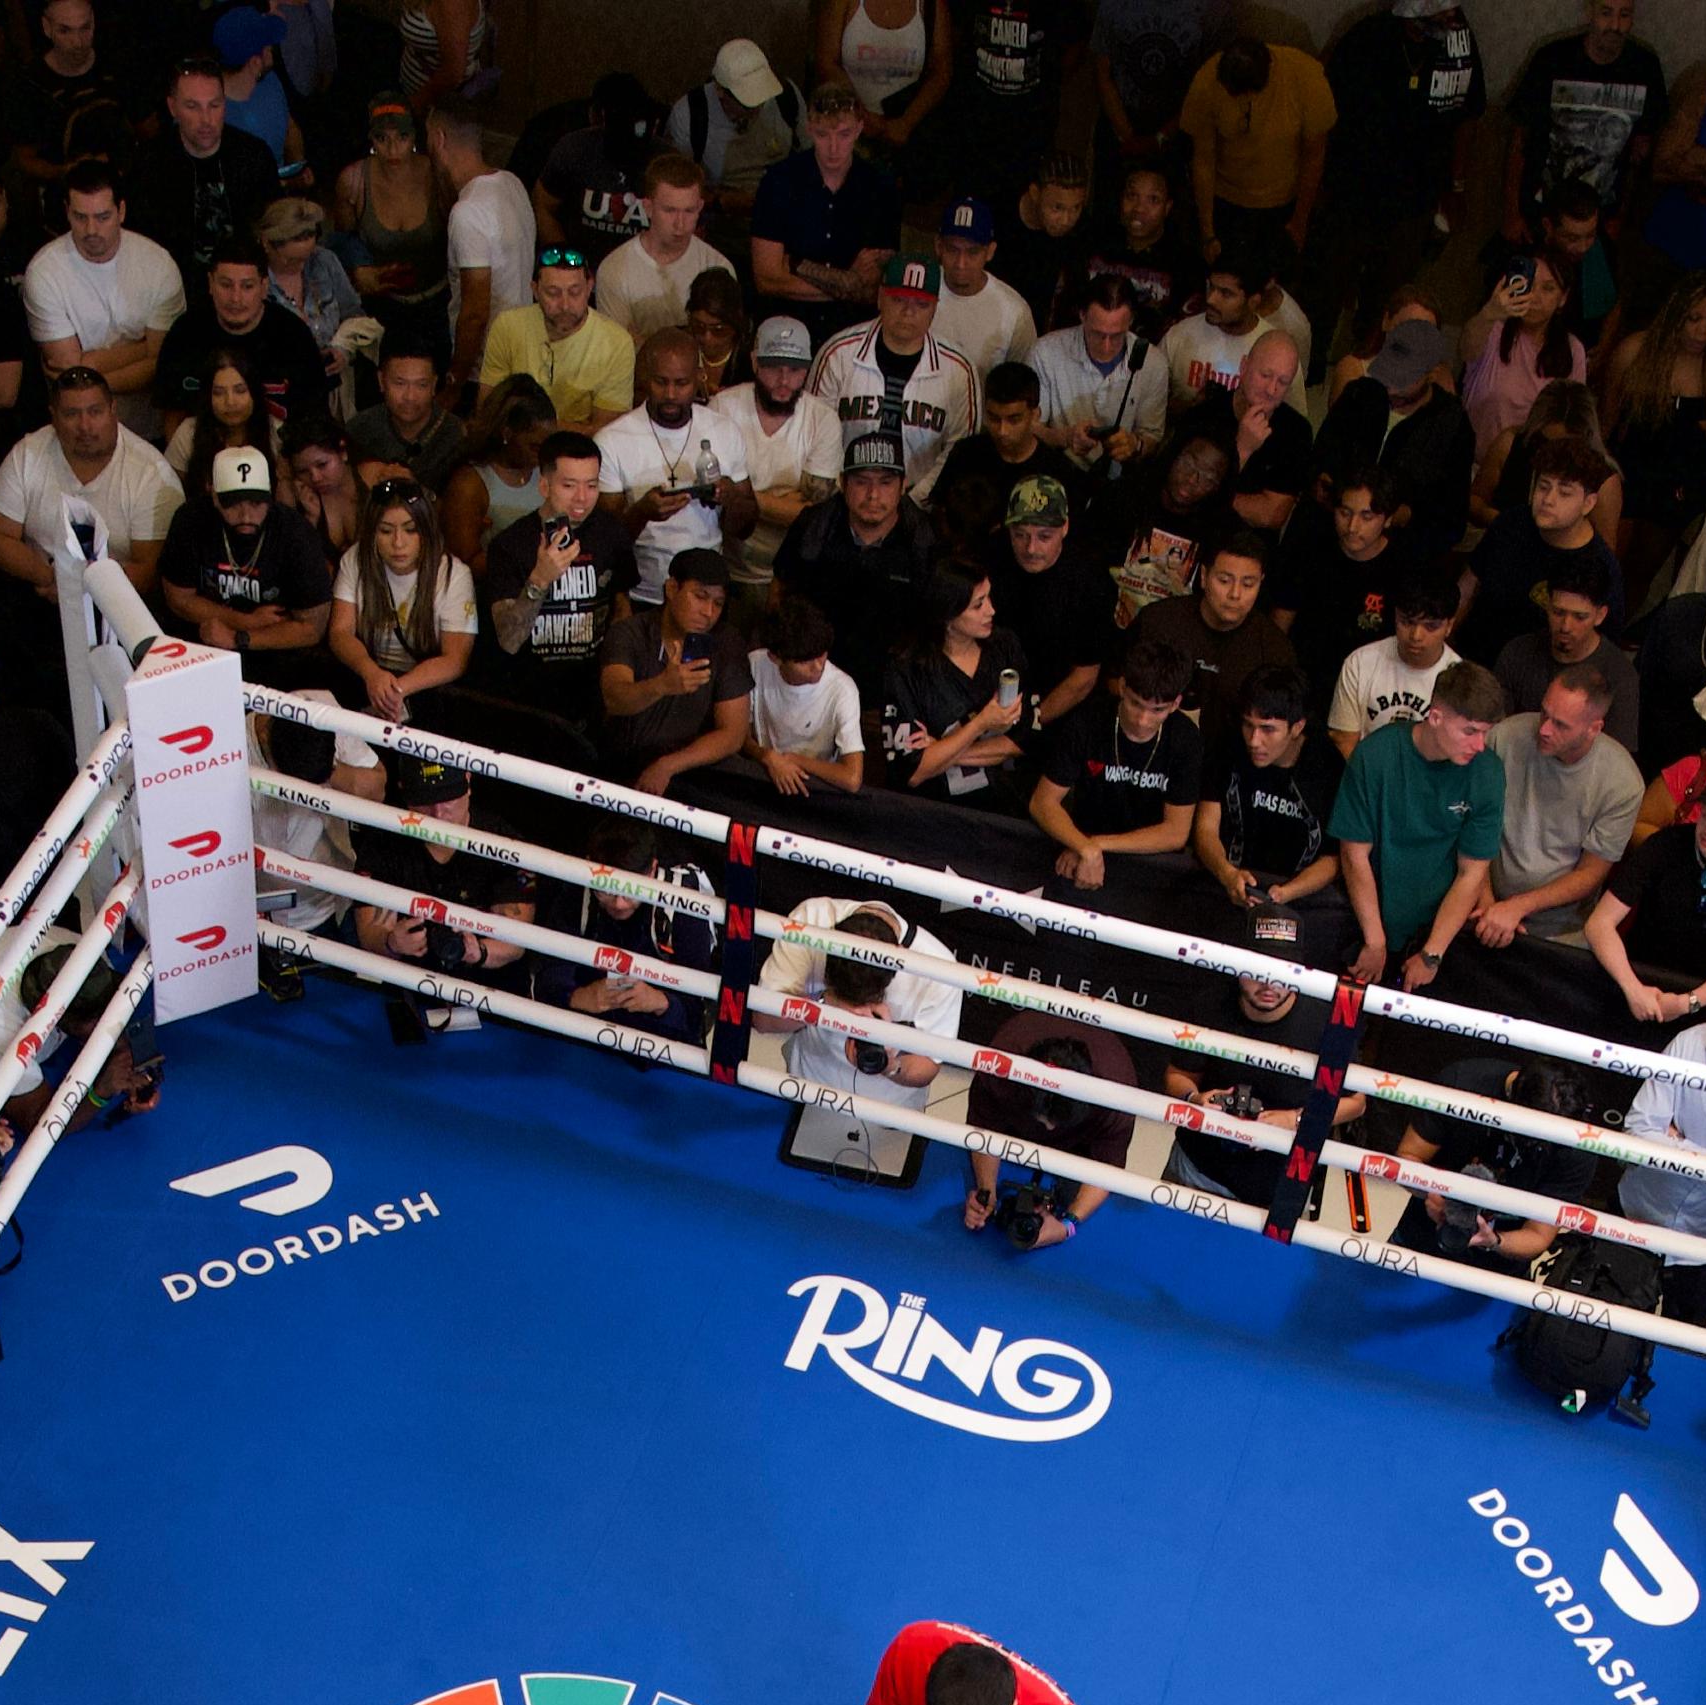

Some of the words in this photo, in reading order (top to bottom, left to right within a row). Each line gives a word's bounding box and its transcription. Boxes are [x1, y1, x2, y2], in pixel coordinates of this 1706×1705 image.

[902, 261, 927, 290] M
[236, 462, 253, 482] P
[853, 440, 896, 465] RAIDERS
[218, 574, 261, 603] CANELO
[143, 652, 215, 679] DOORDASH
[243, 690, 309, 727] perian
[141, 749, 244, 789] DOORDASH
[397, 733, 500, 780] experian
[1104, 764, 1140, 785] VARGAS
[589, 789, 694, 833] experian
[399, 823, 521, 865] DRAFTKINGS
[730, 822, 757, 867] N
[151, 851, 249, 890] DOORDASH
[788, 848, 894, 887] experian
[590, 873, 712, 917] DRAFTKINGS
[727, 904, 753, 940] N
[158, 944, 254, 982] DOORDASH
[781, 930, 906, 972] DRAFTKINGS
[719, 987, 745, 1026] N
[977, 983, 1103, 1027] DRAFTKINGS
[1331, 985, 1363, 1028] N
[1173, 1037, 1301, 1077] DRAFTKINGS
[1317, 1066, 1344, 1098] N
[1374, 1084, 1503, 1128] DRAFTKINGS
[1287, 1146, 1317, 1182] N
[1576, 1137, 1705, 1181] DRAFTKINGS
[161, 1191, 441, 1303] DOORDASH
[898, 1291, 927, 1312] THE
[783, 1273, 1112, 1443] RING
